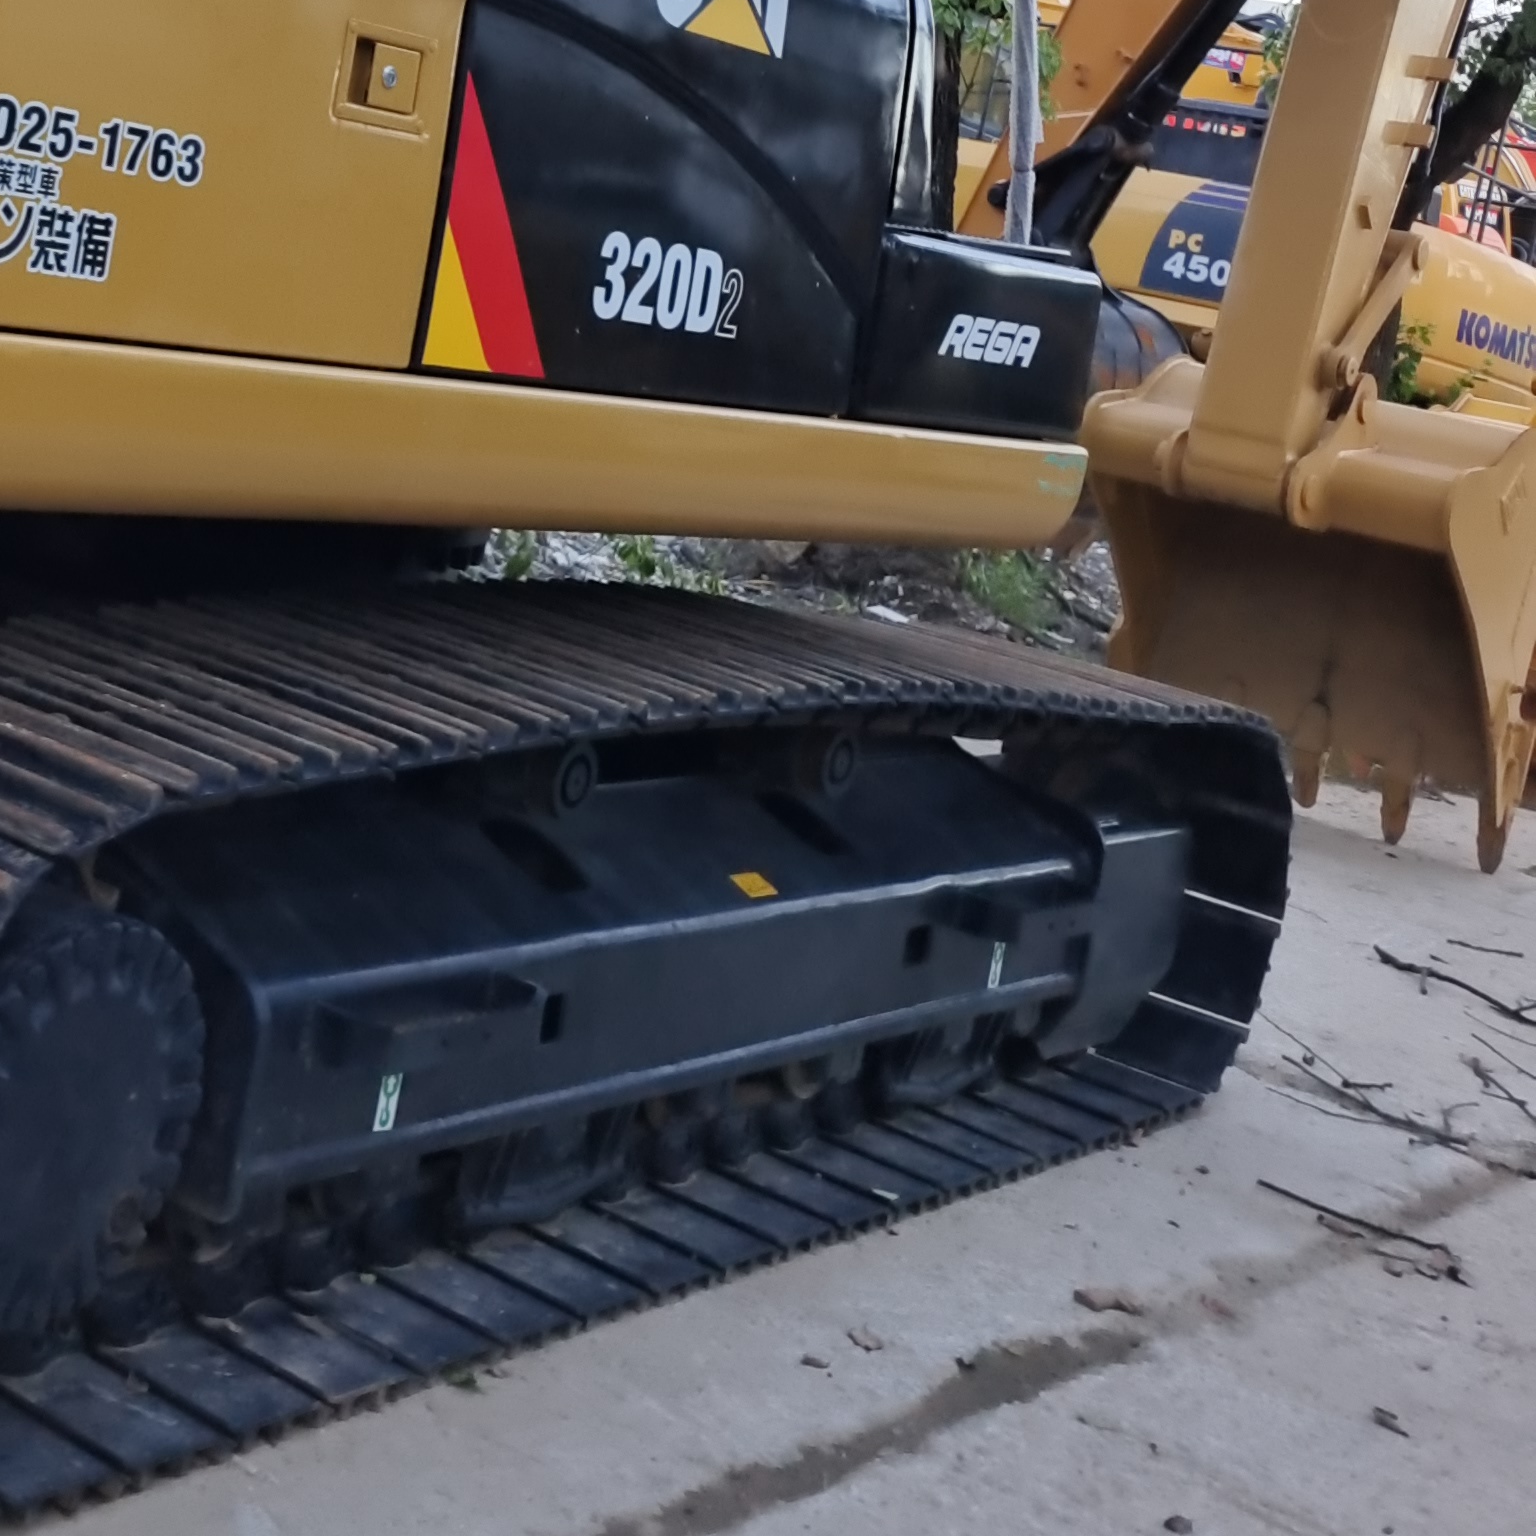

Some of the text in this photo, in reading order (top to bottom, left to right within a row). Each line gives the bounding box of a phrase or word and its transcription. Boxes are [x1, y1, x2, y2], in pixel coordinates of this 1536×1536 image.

[1167, 228, 1204, 254] PC
[592, 230, 744, 339] 320D2
[1162, 250, 1231, 288] 450
[937, 313, 1041, 369] REGA
